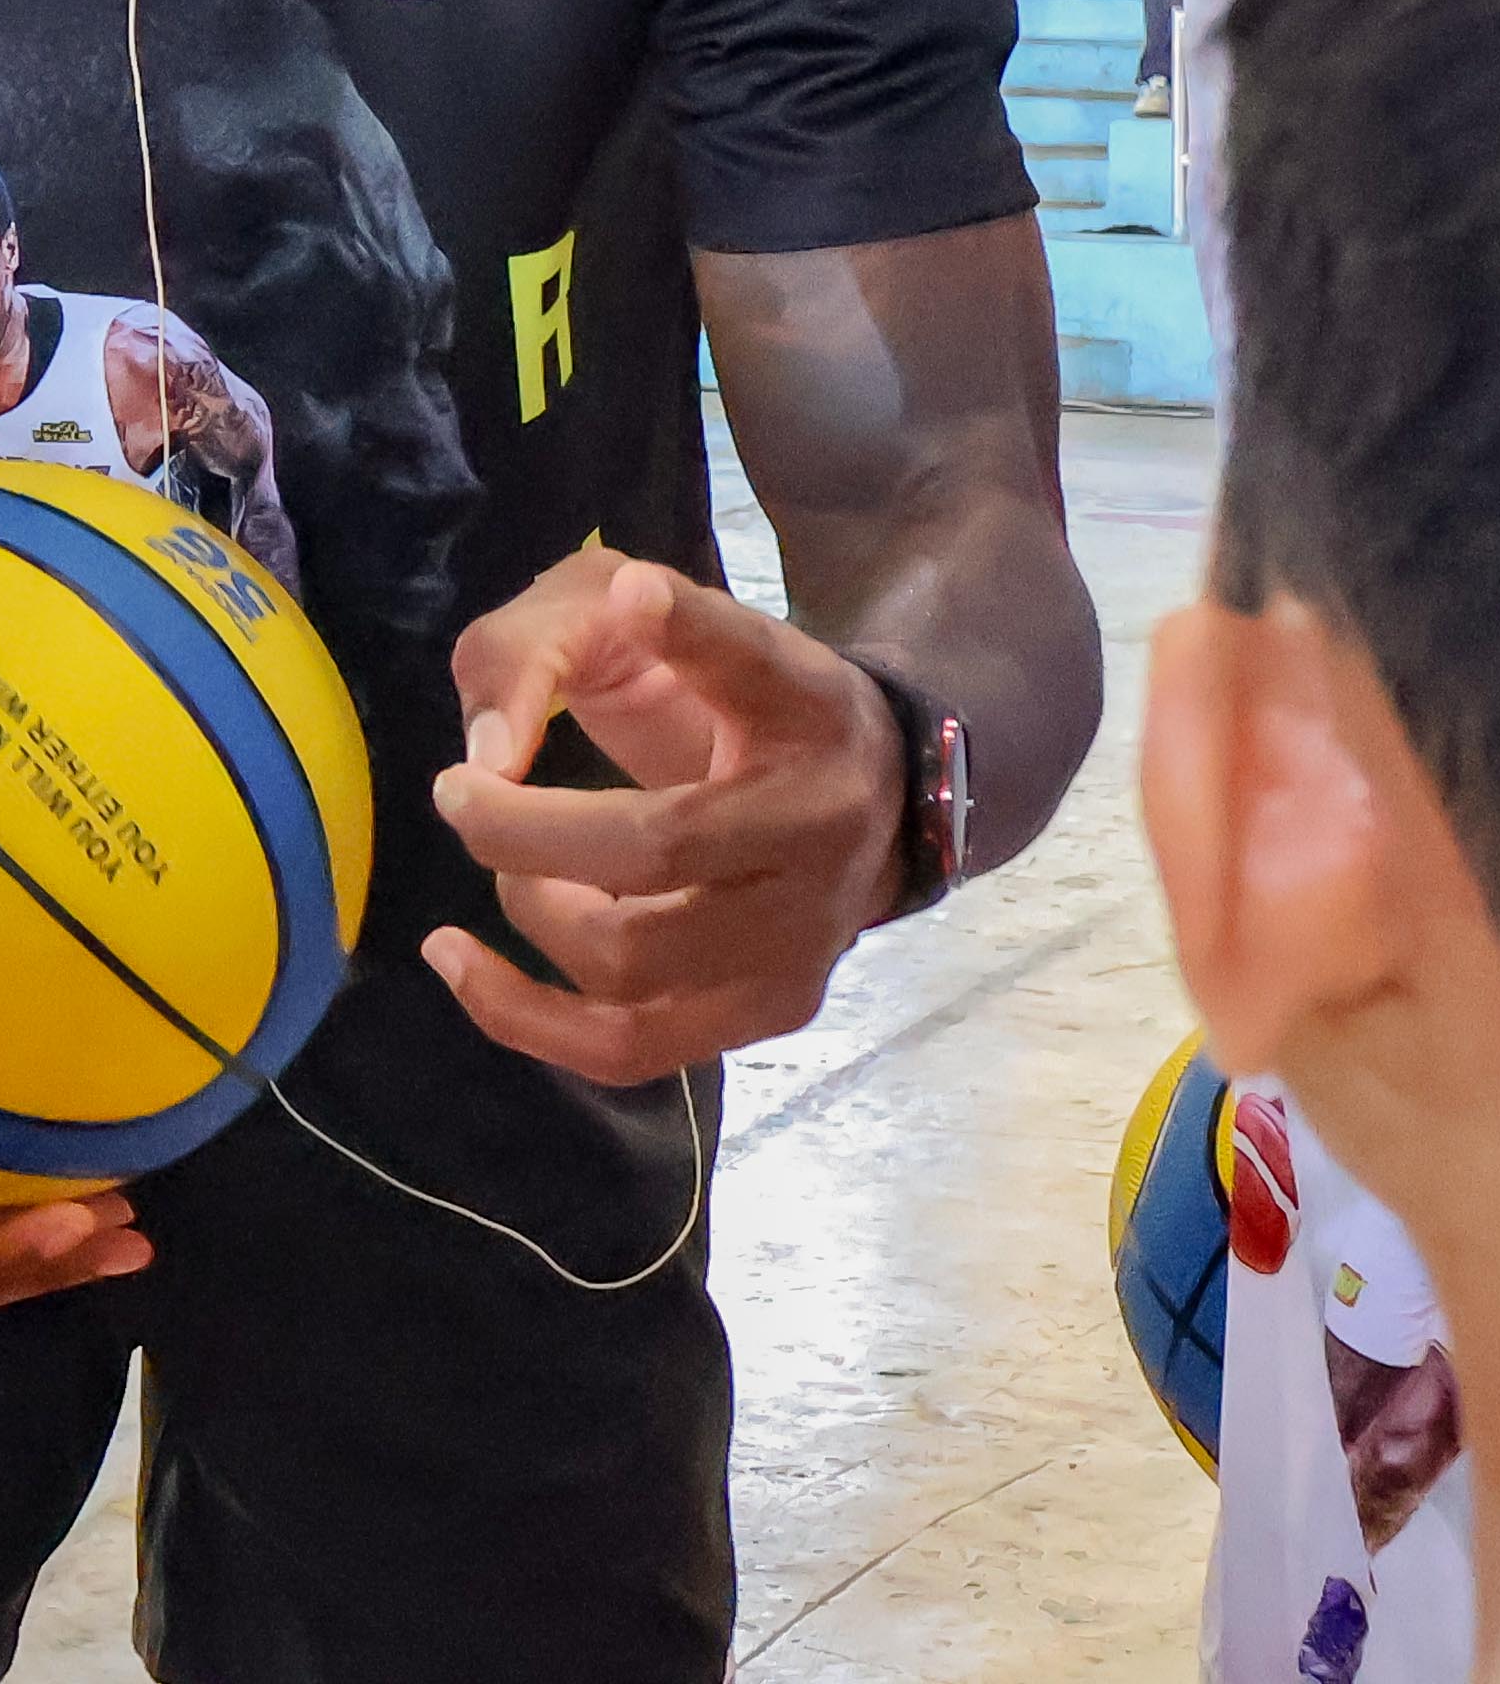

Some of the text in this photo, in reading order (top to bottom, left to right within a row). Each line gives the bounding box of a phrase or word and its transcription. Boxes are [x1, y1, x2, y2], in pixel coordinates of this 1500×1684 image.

[6, 744, 72, 821] WILL
[26, 716, 124, 824] EITHER
[66, 815, 122, 883] YOU
[114, 819, 168, 885] YOU
